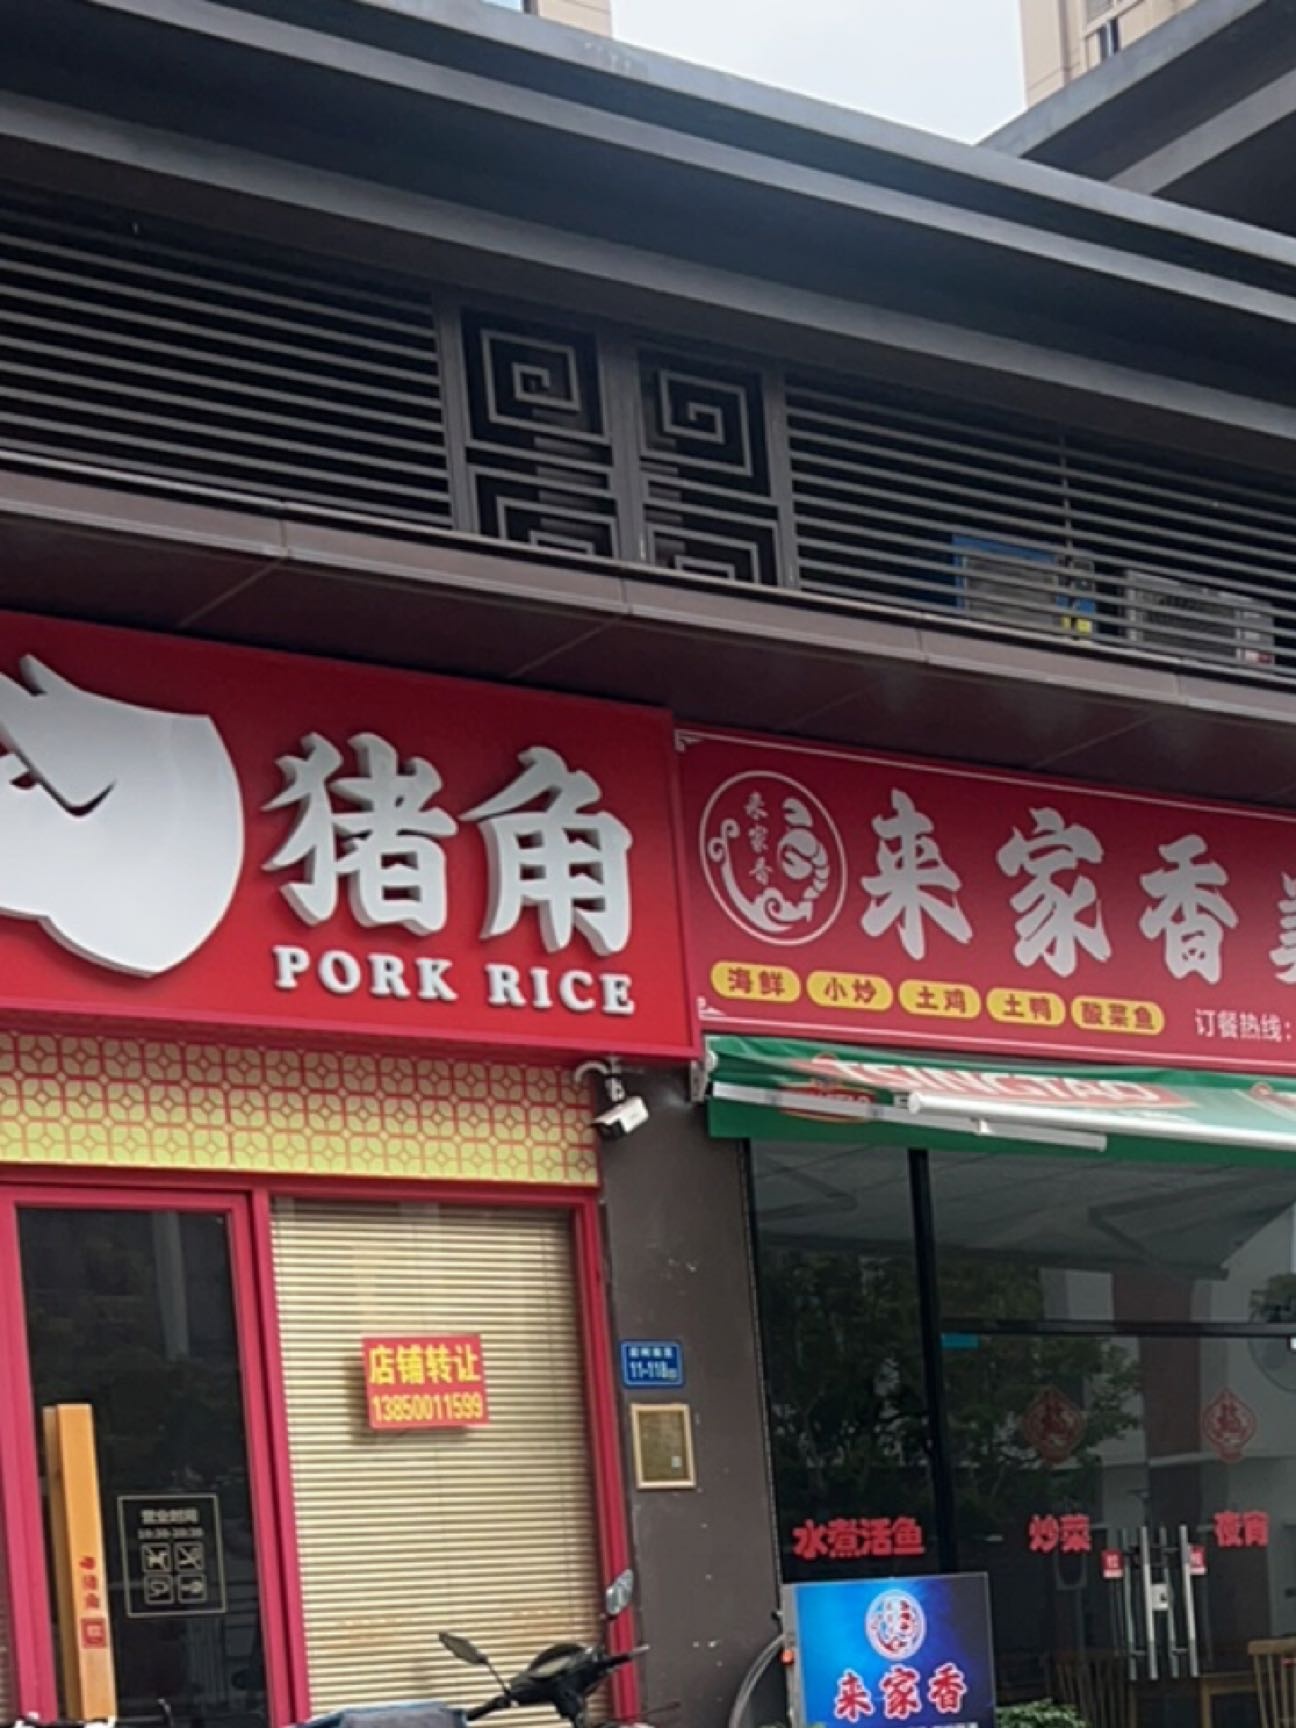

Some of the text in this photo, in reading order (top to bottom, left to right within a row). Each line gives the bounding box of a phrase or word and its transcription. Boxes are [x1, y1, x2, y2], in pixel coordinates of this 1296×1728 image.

[261, 731, 634, 956] 猪角
[274, 946, 637, 1016] PORK RICE
[727, 967, 785, 996] 海鲜
[824, 977, 878, 1004] 小炒
[915, 986, 967, 1015] 土鸡
[1002, 994, 1052, 1021] 土鸭
[369, 1343, 482, 1385] 店铺转让
[792, 1517, 925, 1559] 水煮活鱼
[1028, 1513, 1092, 1553] 炒菜
[1213, 1509, 1270, 1548] 夜宵
[833, 1662, 968, 1724] 来家香
